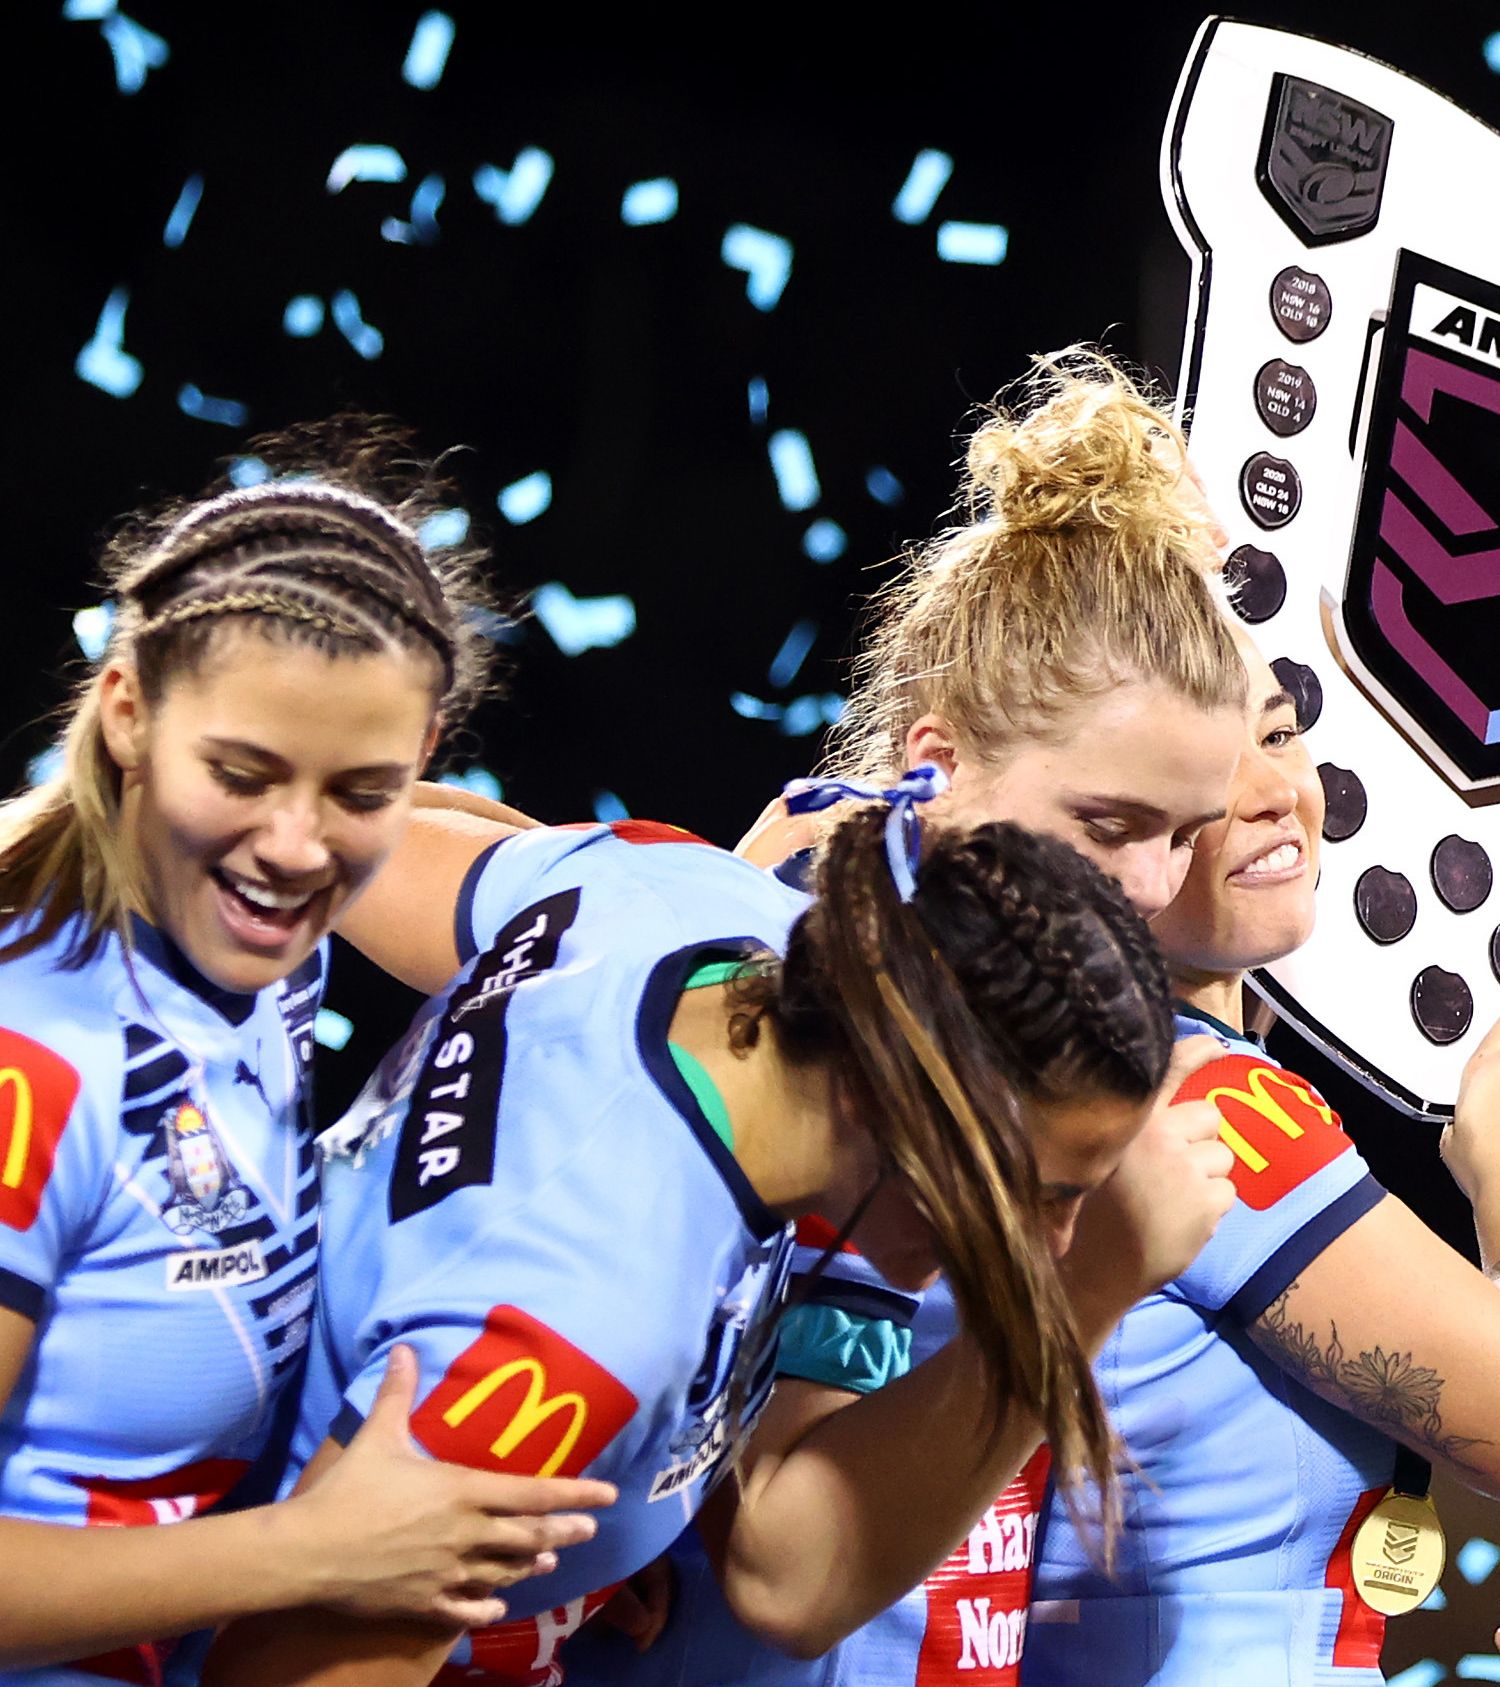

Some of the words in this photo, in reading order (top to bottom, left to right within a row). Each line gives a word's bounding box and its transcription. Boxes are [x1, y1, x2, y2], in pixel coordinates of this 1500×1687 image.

[1291, 276, 1316, 294] 2018
[1281, 291, 1306, 308] NSW
[1278, 371, 1303, 389] 2019
[1267, 386, 1291, 403] NSW
[1294, 396, 1306, 410] 14
[1267, 401, 1290, 417] QLD
[1263, 467, 1286, 483] 2020
[1255, 482, 1277, 497] QLD
[1277, 489, 1289, 501] 24
[1253, 494, 1277, 510] NSW
[481, 913, 548, 993] THE
[418, 1031, 475, 1187] STAR
[173, 1251, 260, 1284] AMPOL
[1373, 1569, 1414, 1585] ORIGIN
